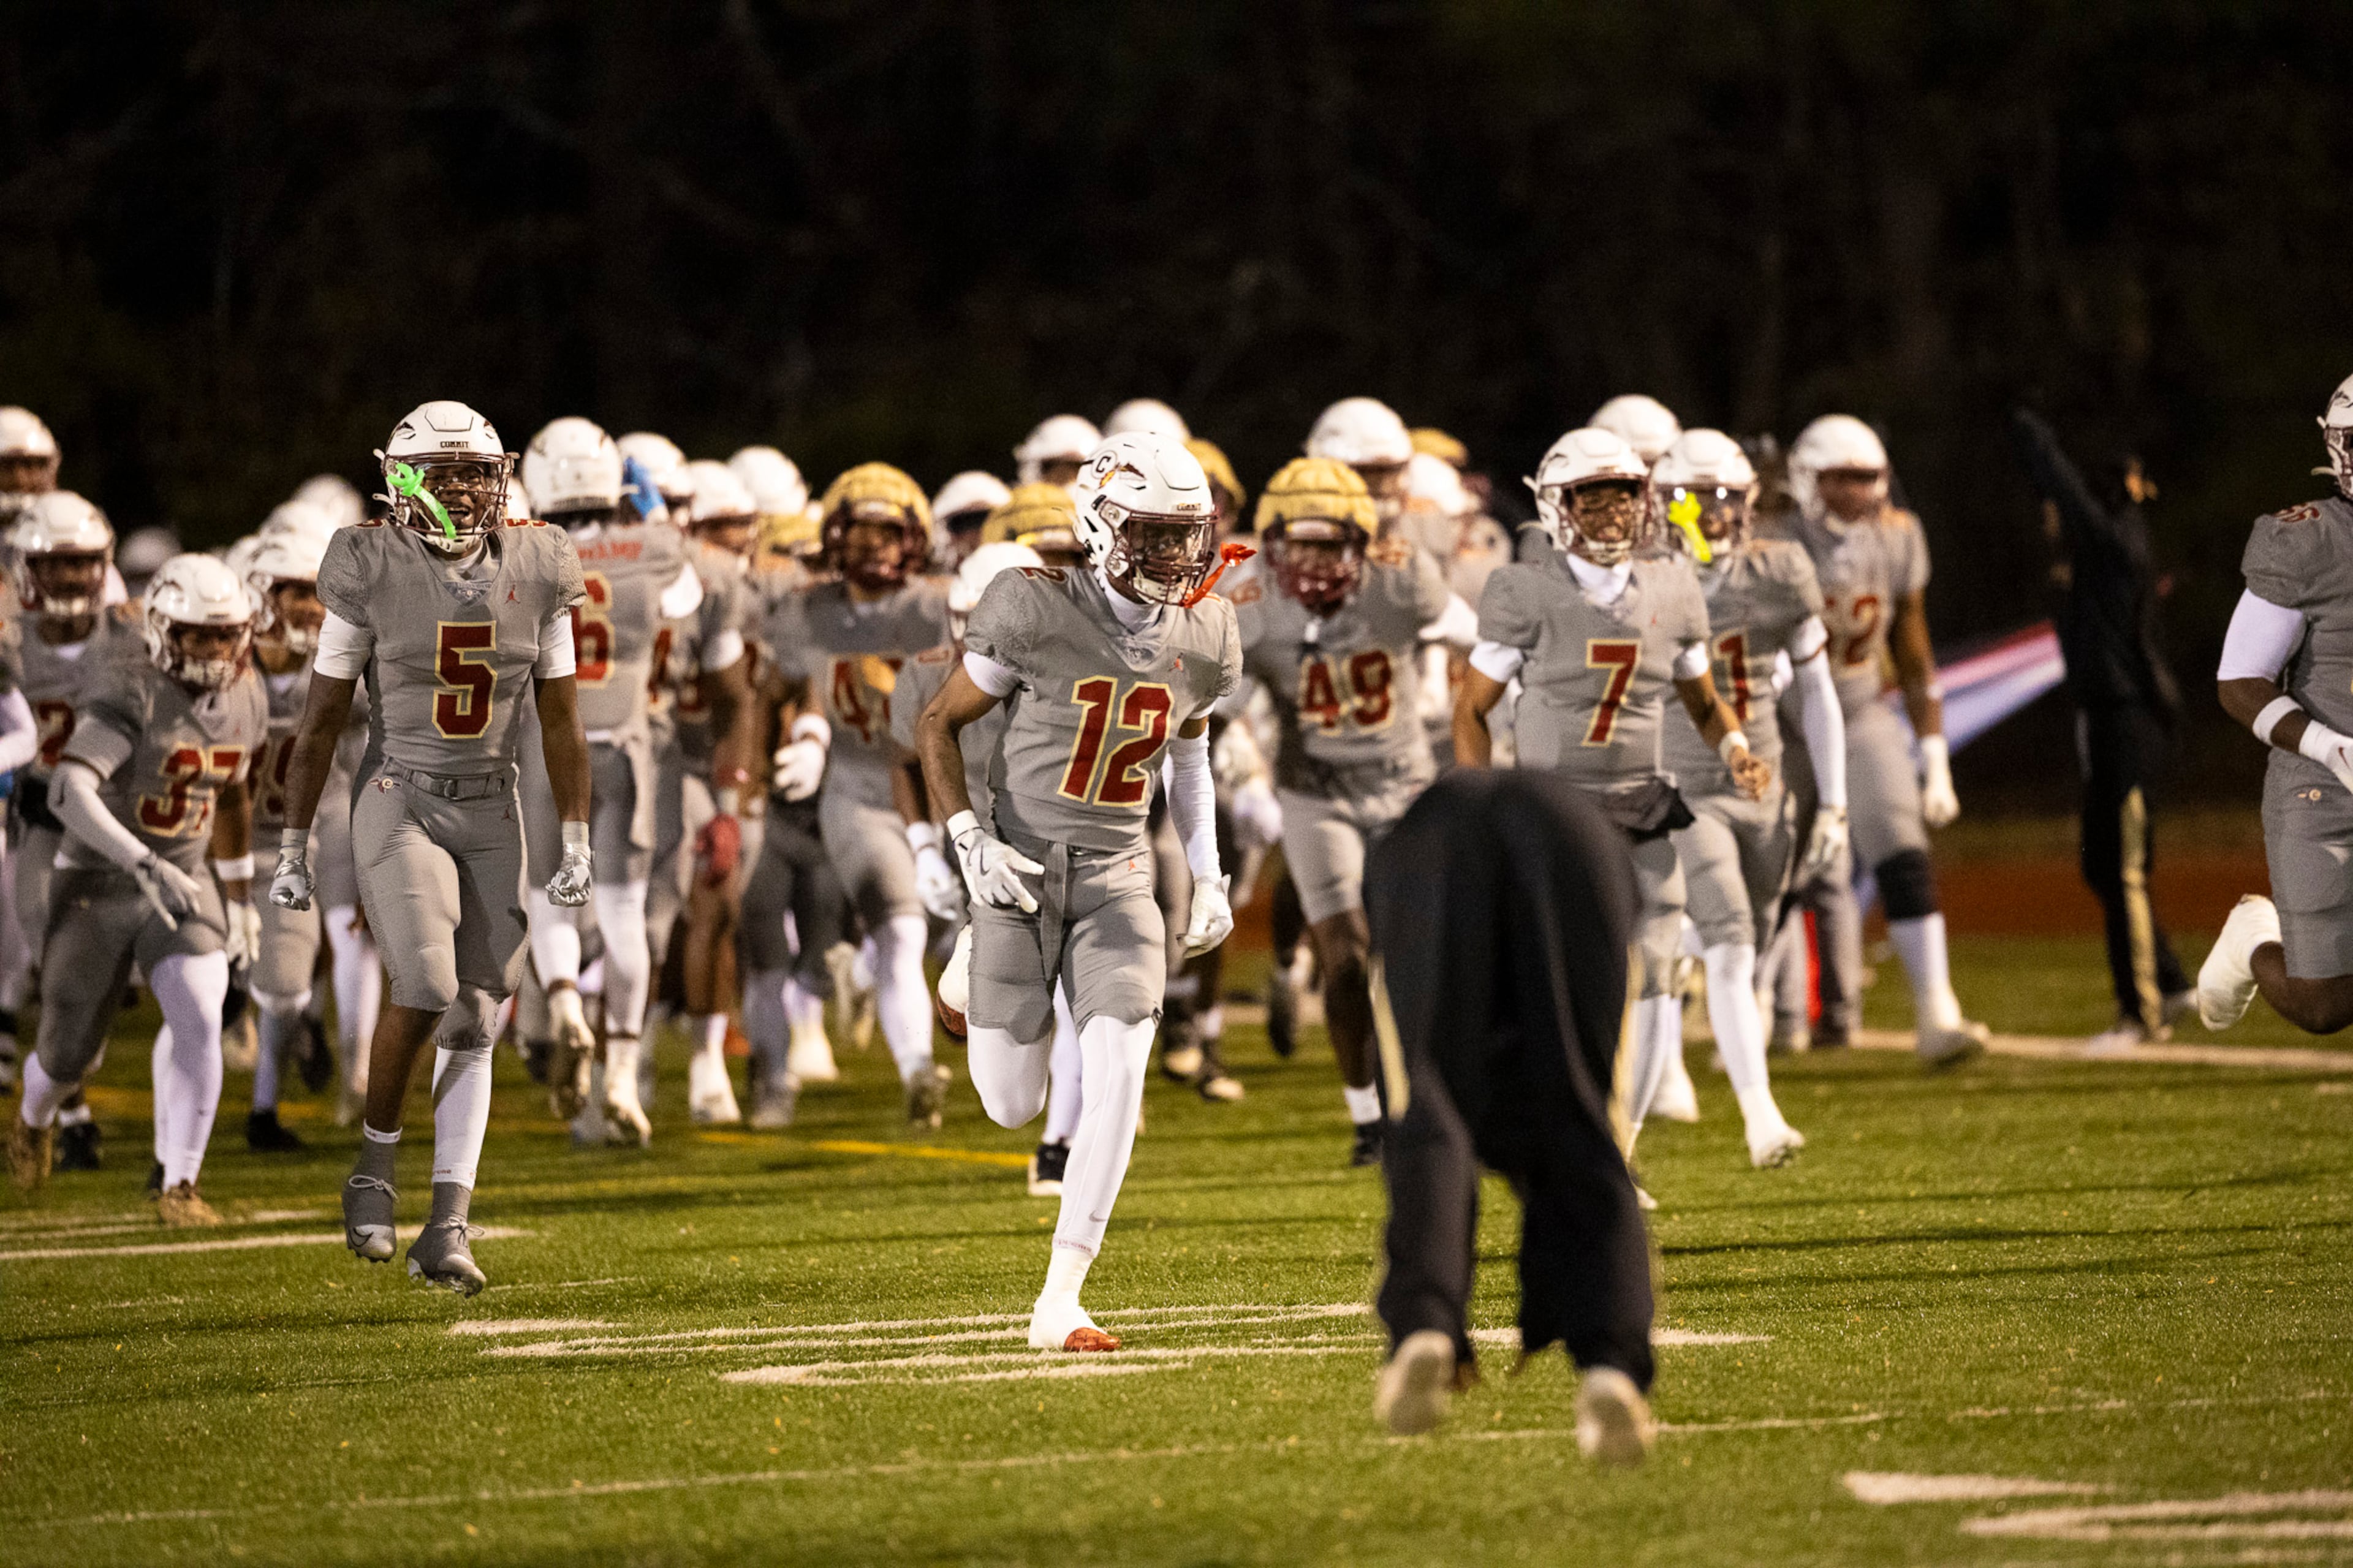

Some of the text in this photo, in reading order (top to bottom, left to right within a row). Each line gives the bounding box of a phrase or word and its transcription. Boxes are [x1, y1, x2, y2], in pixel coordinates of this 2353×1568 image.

[1095, 455, 1112, 473] C
[431, 620, 498, 739] 5
[1297, 650, 1397, 737] 49
[1581, 638, 1642, 748] 7
[134, 740, 246, 838] 37
[1056, 675, 1175, 808] 12
